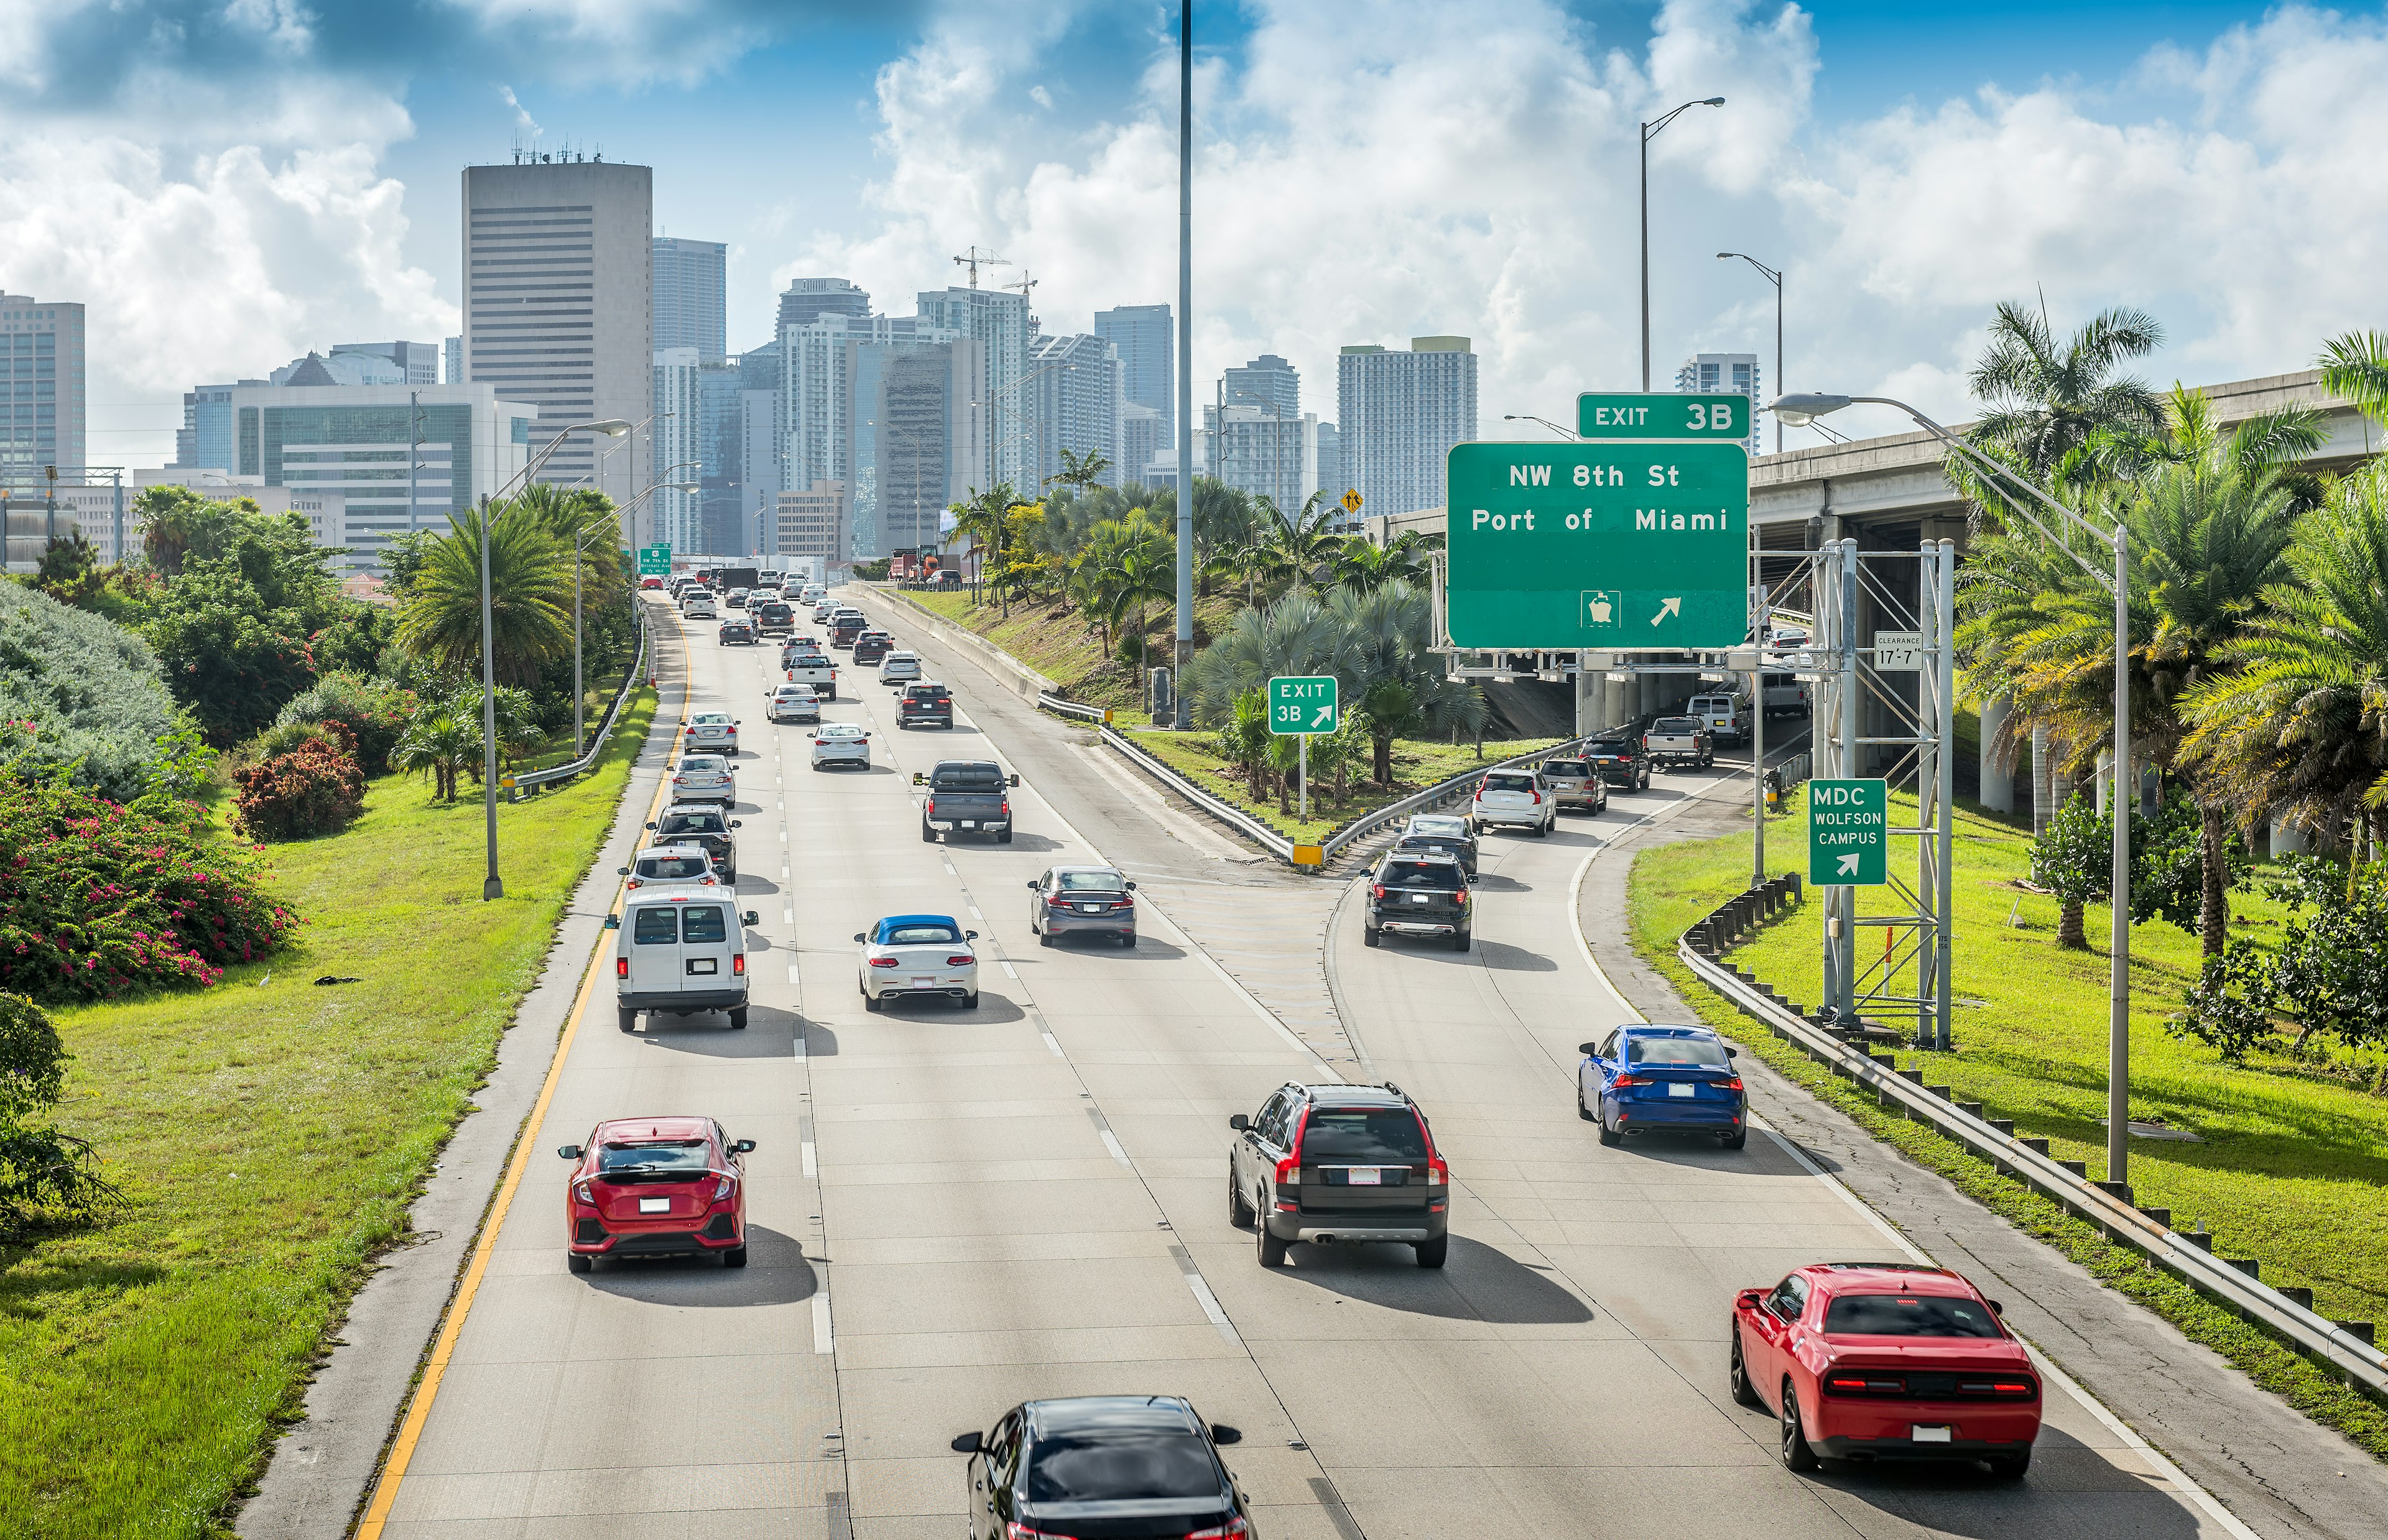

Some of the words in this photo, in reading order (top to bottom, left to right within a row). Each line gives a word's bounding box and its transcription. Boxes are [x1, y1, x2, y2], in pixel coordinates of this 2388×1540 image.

[1596, 407, 1649, 425] EXIT
[1686, 403, 1732, 430] 3B
[1510, 465, 1552, 486] NW
[1573, 464, 1624, 487] 8th
[1648, 464, 1679, 487] St
[1473, 509, 1535, 530] Port
[1565, 508, 1592, 530] of
[1636, 509, 1726, 530] Miami
[1281, 684, 1325, 698] EXIT
[1277, 705, 1301, 721] 3B
[1814, 787, 1865, 806] MDC
[1815, 813, 1881, 825] WOLFSON
[1819, 832, 1877, 845] CAMPUS
